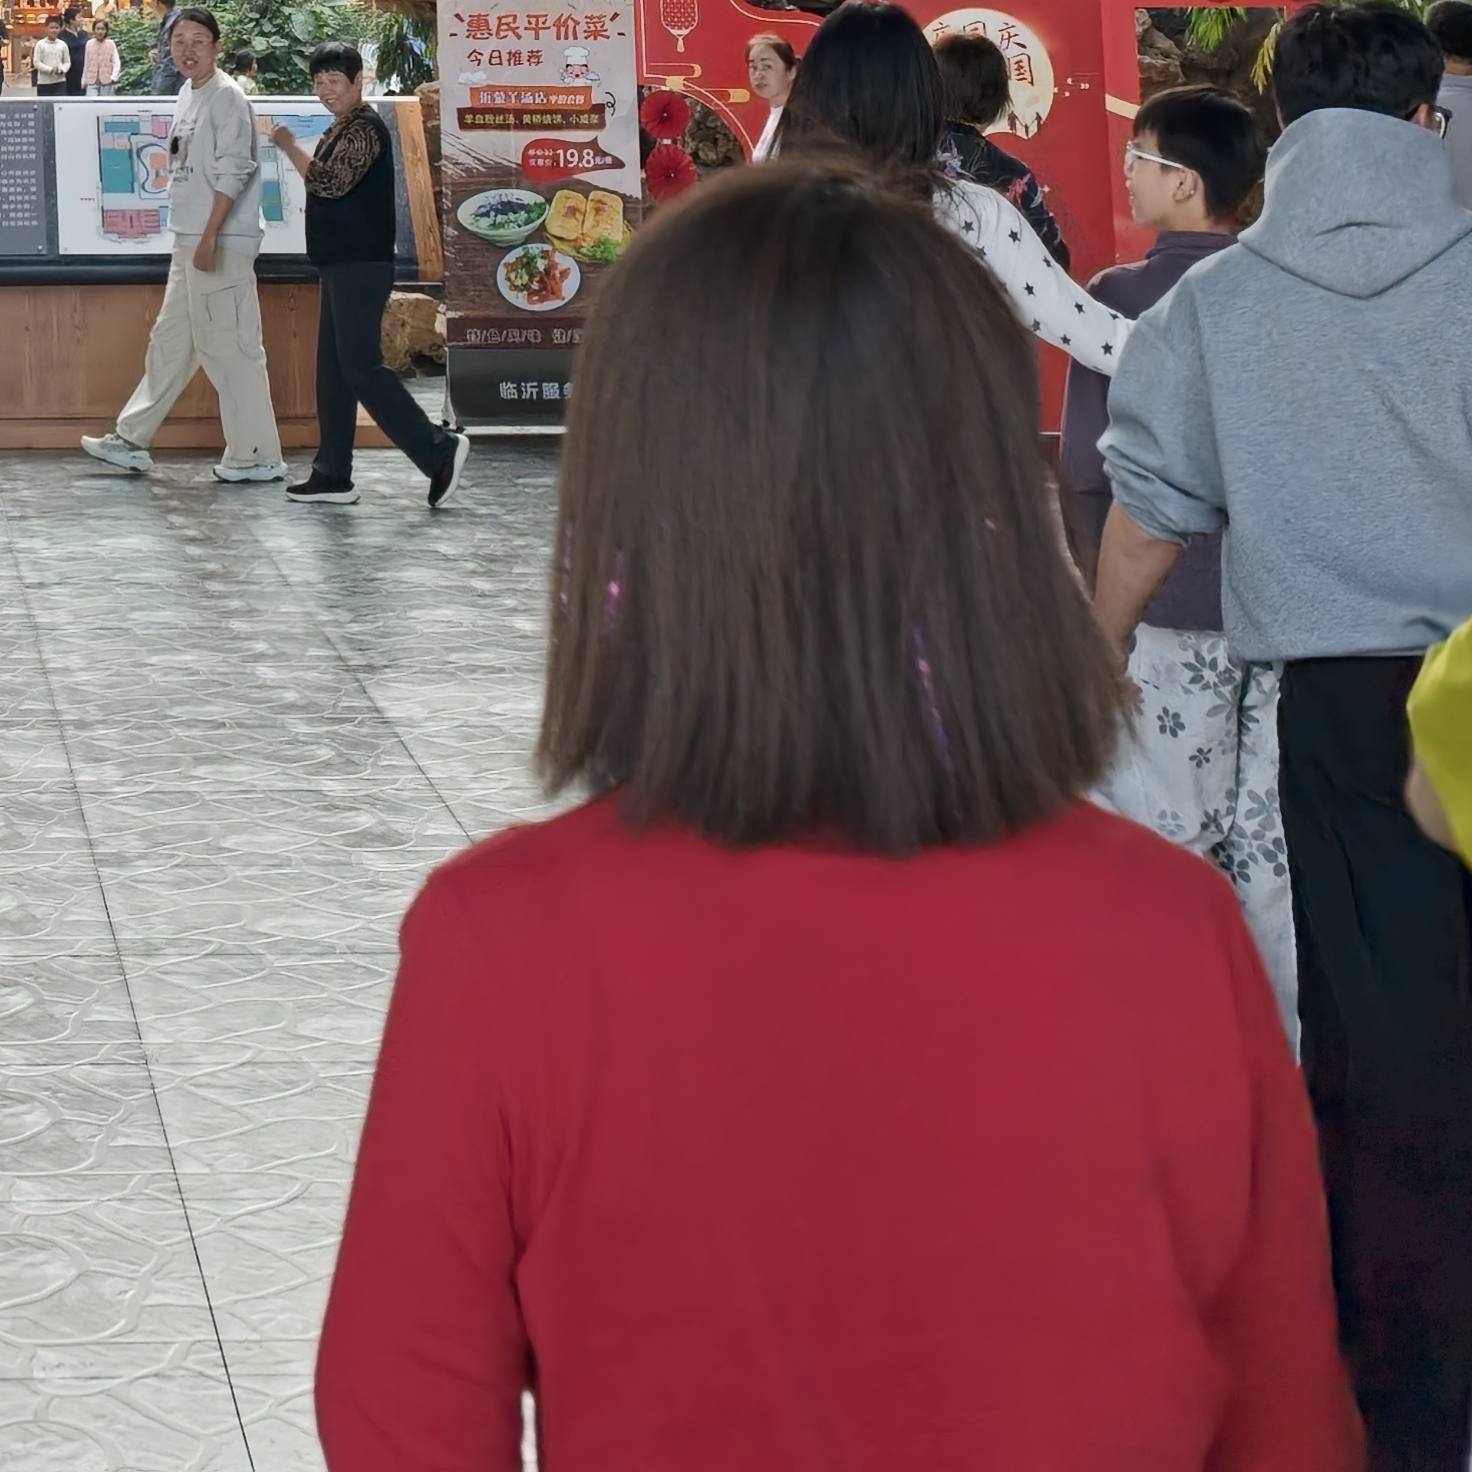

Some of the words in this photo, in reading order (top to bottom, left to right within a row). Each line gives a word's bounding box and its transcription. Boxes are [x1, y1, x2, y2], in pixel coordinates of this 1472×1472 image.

[465, 13, 611, 41] 惠民平价菜
[467, 49, 544, 67] 今日推荐
